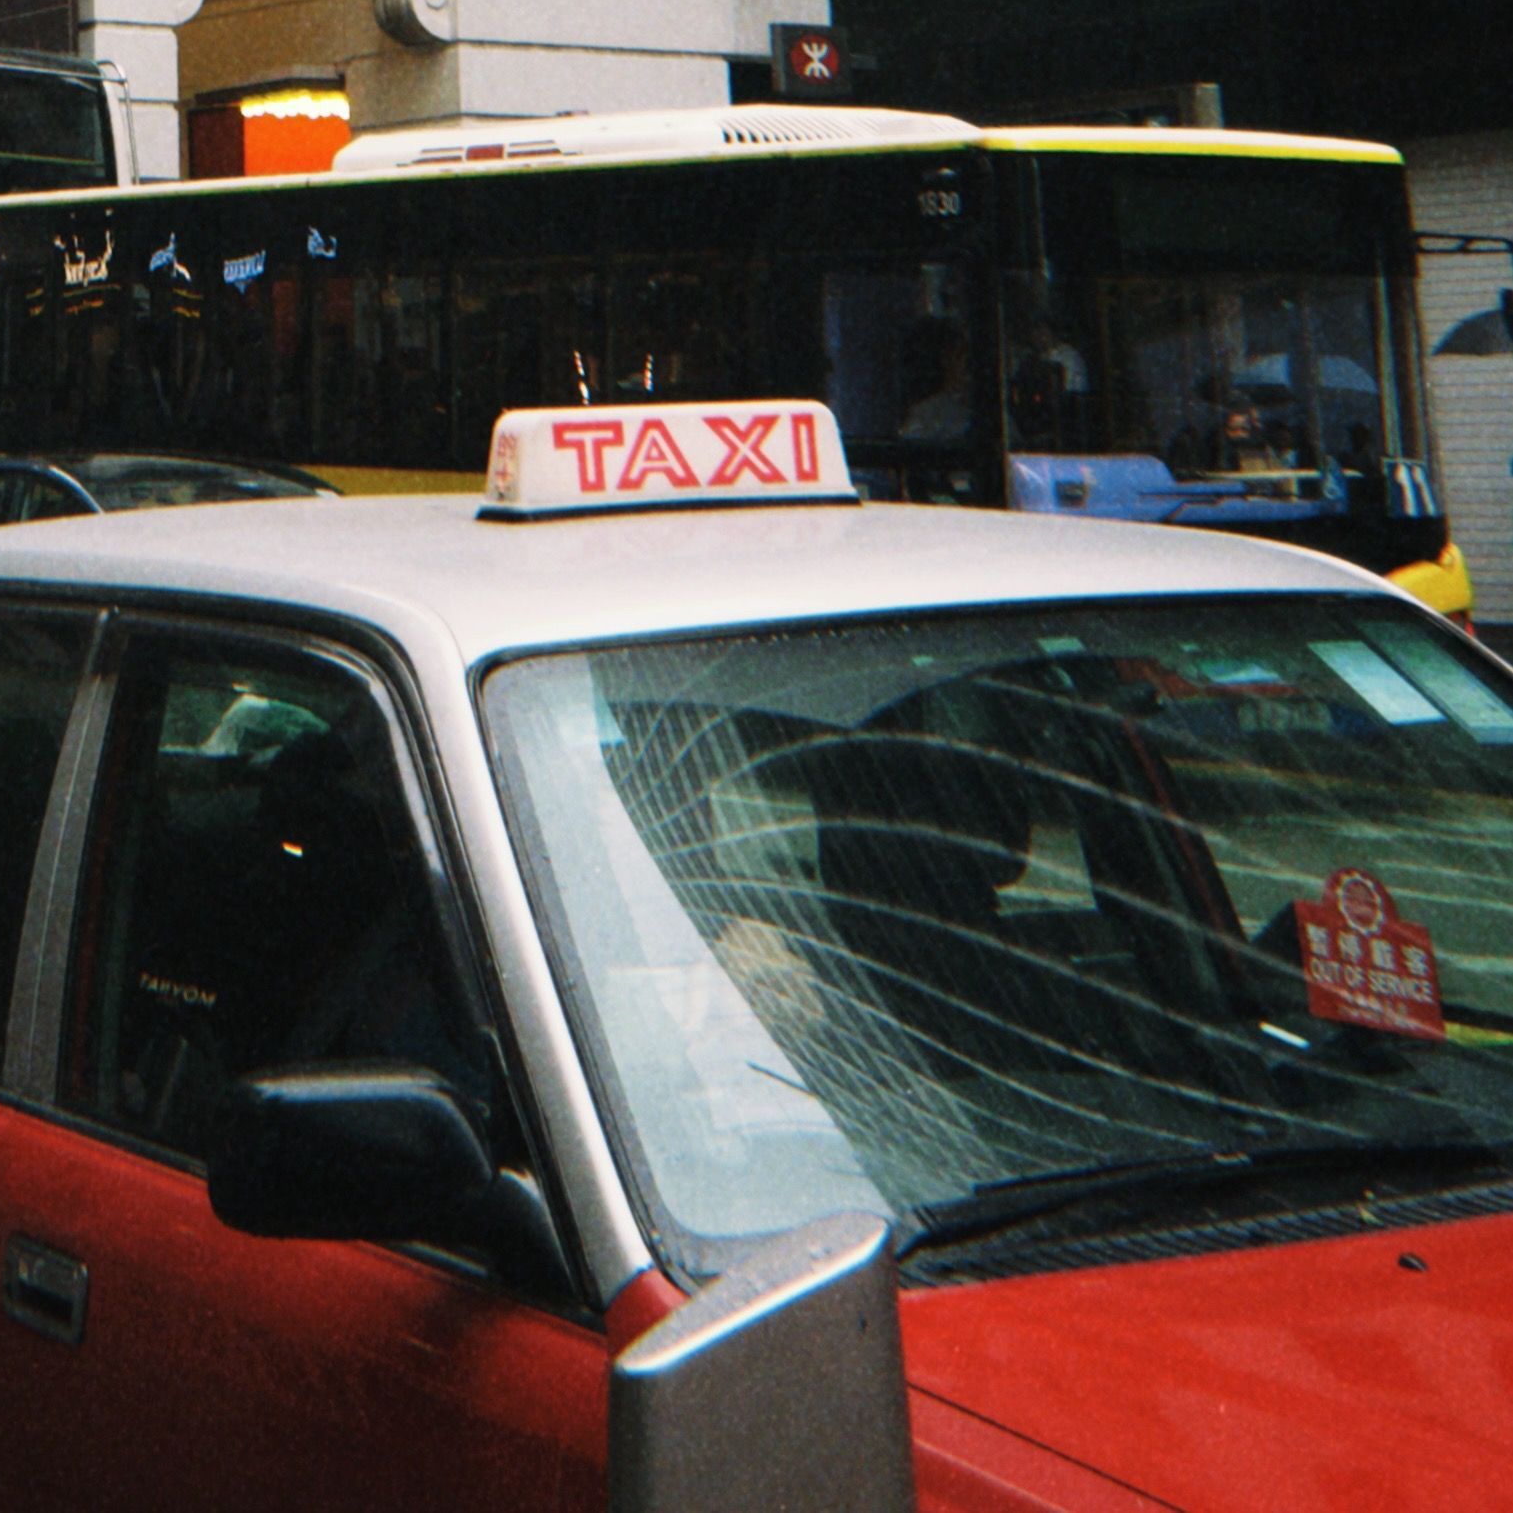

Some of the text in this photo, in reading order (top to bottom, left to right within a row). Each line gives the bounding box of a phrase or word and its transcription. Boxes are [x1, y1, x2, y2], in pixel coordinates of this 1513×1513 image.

[551, 412, 821, 493] TAXI
[1310, 957, 1341, 983] OUT
[1343, 964, 1365, 989] OF
[1367, 970, 1434, 1003] SERVICE
